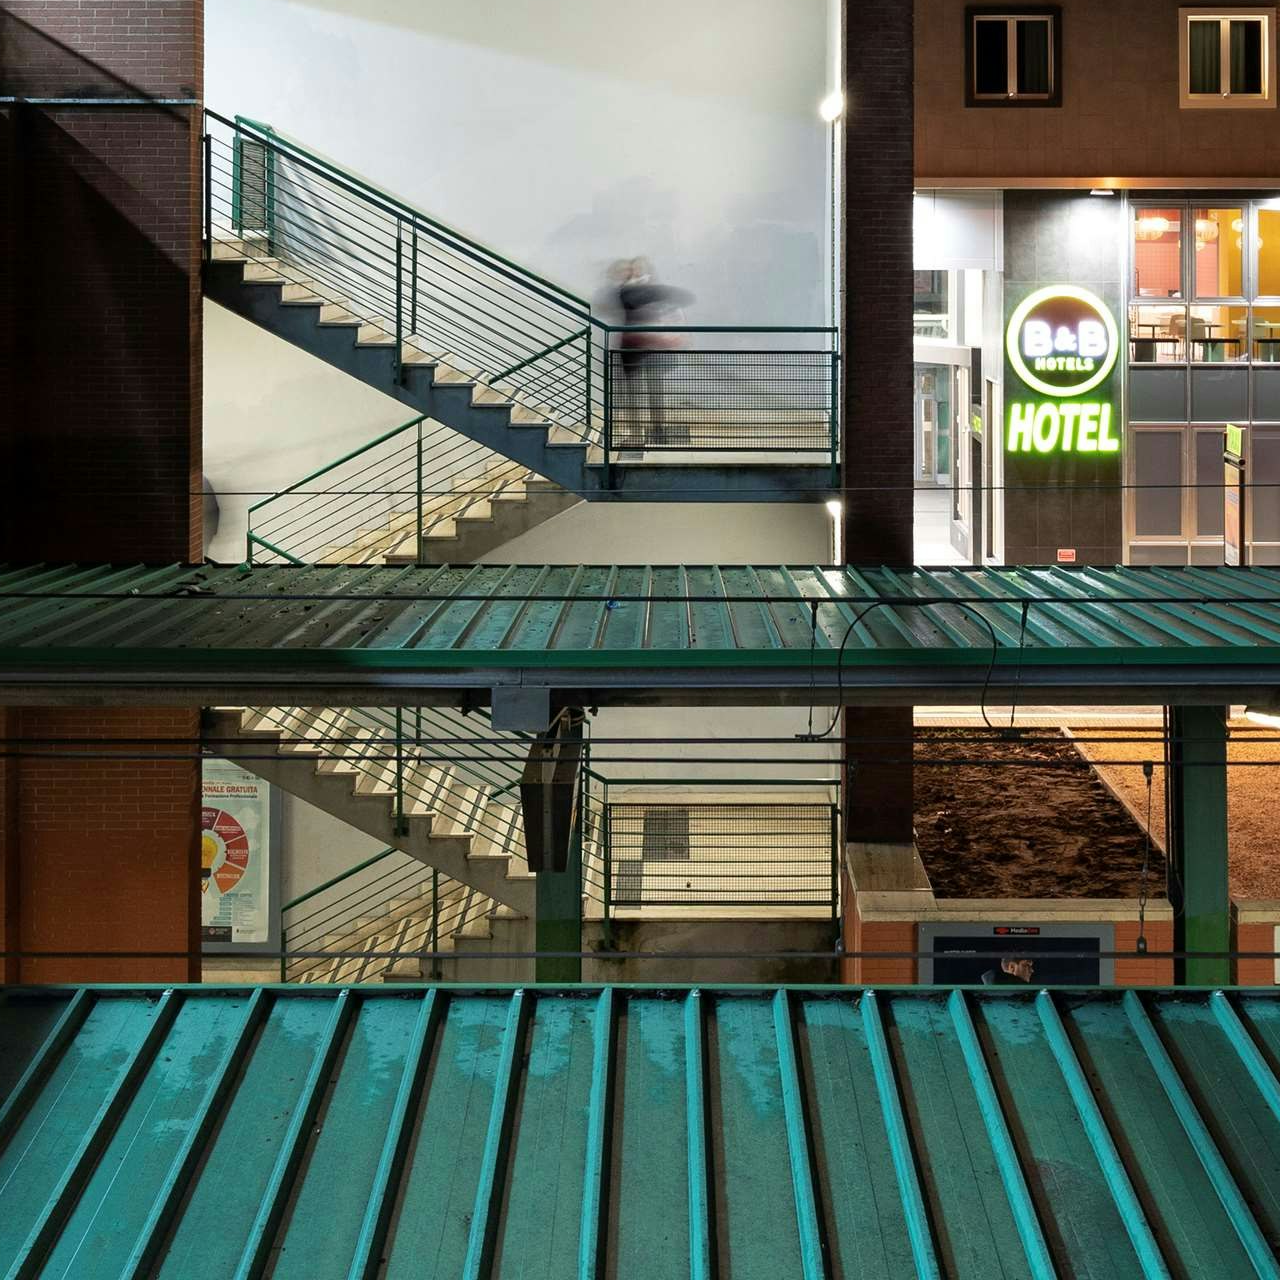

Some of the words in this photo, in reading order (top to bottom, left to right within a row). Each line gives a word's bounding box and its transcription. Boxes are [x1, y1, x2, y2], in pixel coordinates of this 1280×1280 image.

[1023, 320, 1108, 357] B&B
[1034, 357, 1095, 371] HOTELS
[1007, 402, 1120, 453] HOTEL
